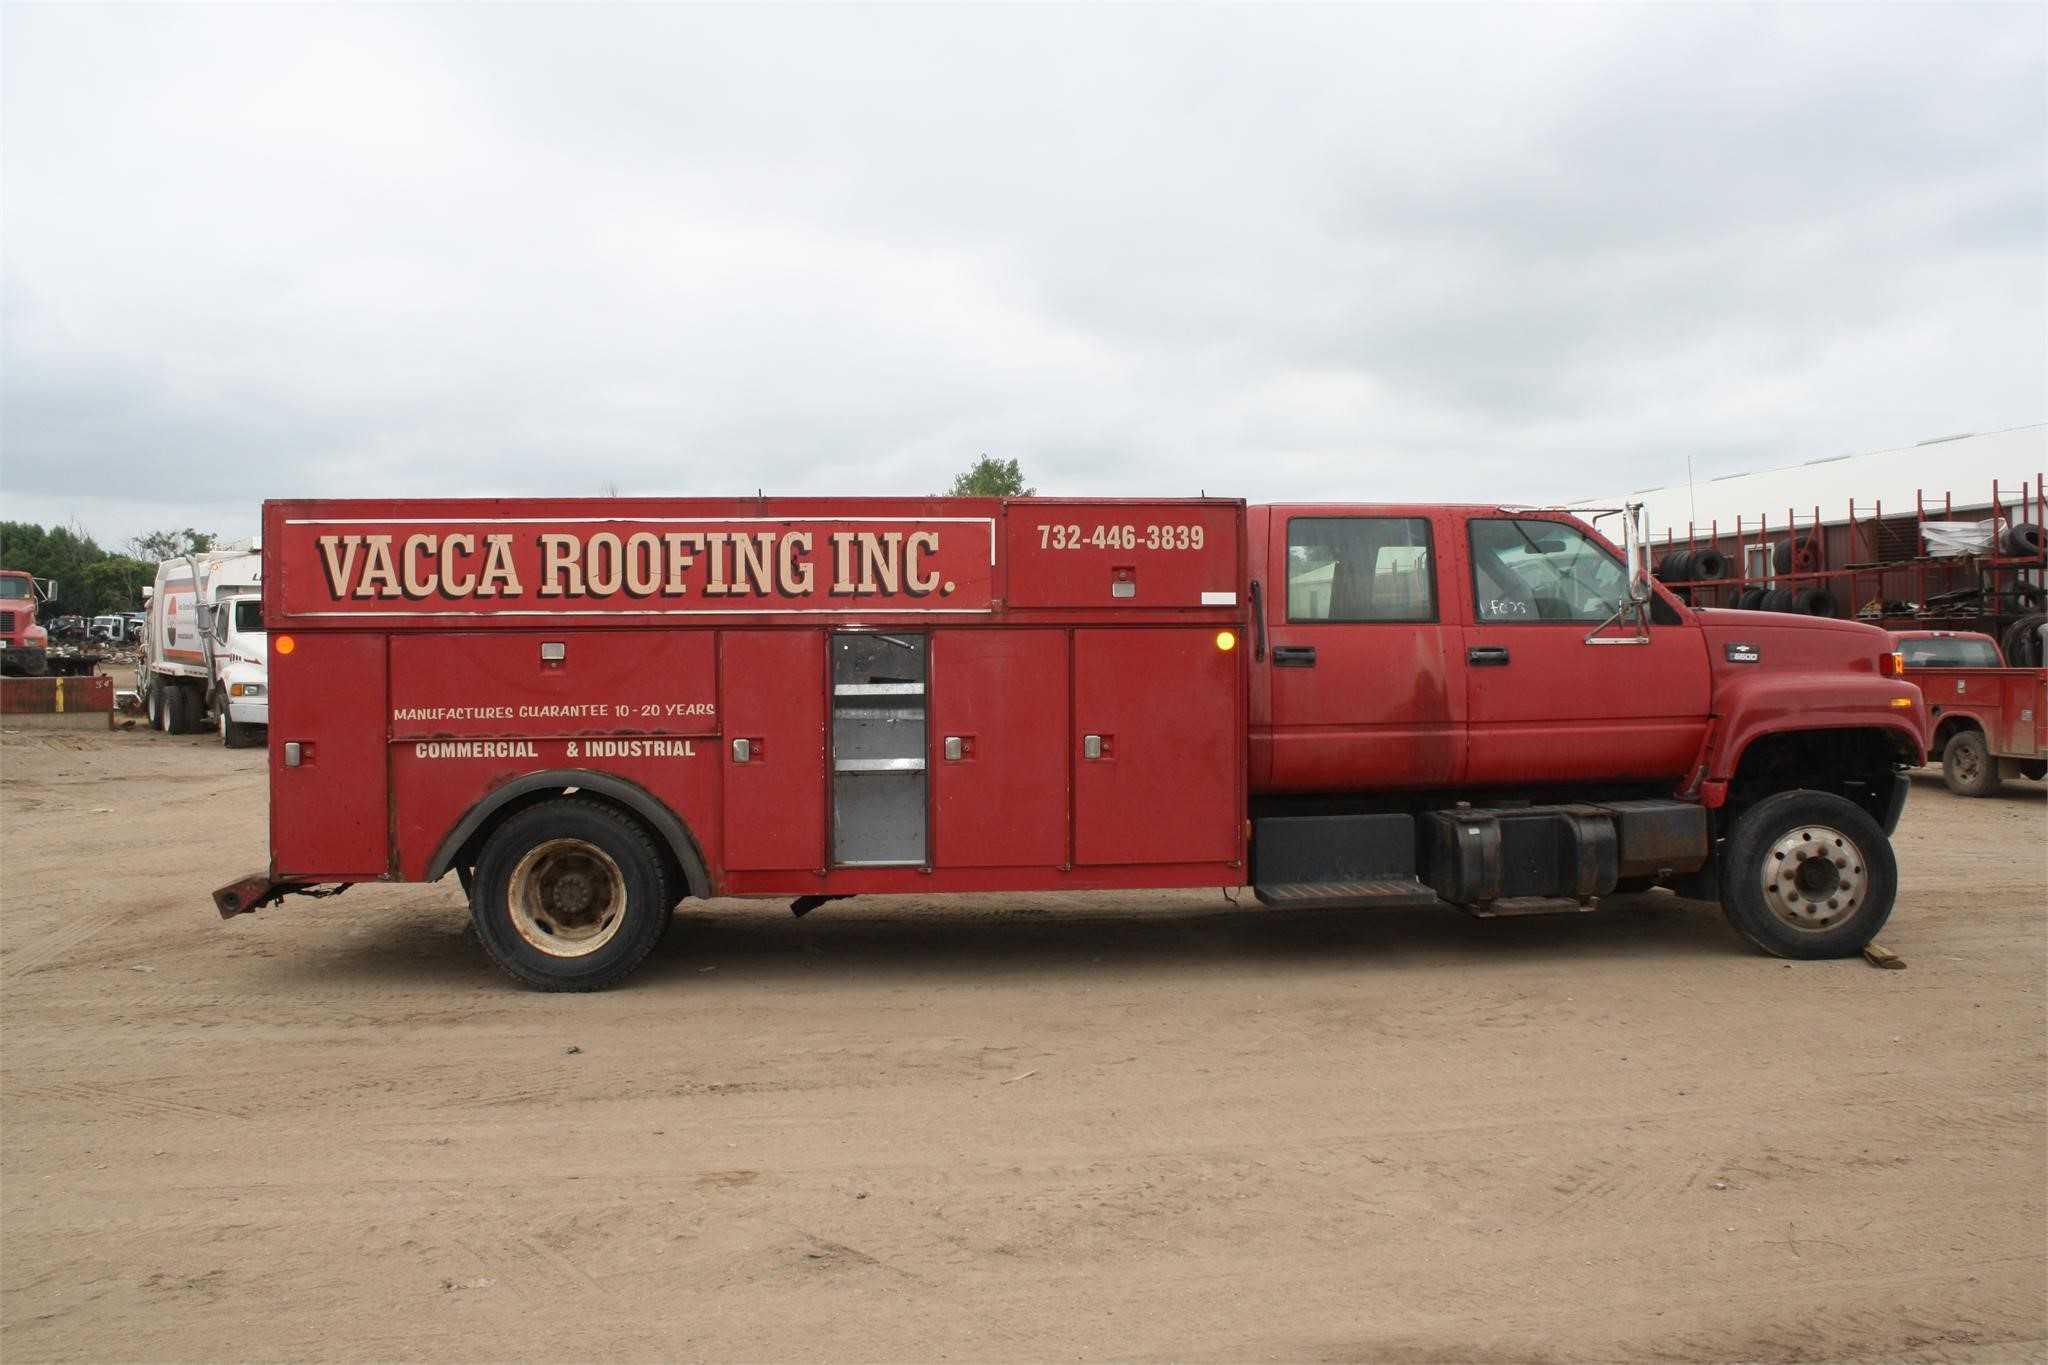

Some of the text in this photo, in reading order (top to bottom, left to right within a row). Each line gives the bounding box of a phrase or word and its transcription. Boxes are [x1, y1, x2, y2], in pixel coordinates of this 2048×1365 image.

[1037, 524, 1204, 550] 732-446-3839
[319, 531, 956, 597] VACCA ROOFING INC.
[394, 706, 514, 720] MANUFACTURES
[519, 704, 608, 718] GUARANTEE
[665, 703, 715, 716] YEARS
[415, 740, 696, 759] COMMERCIAL & INDUSTRIAL
